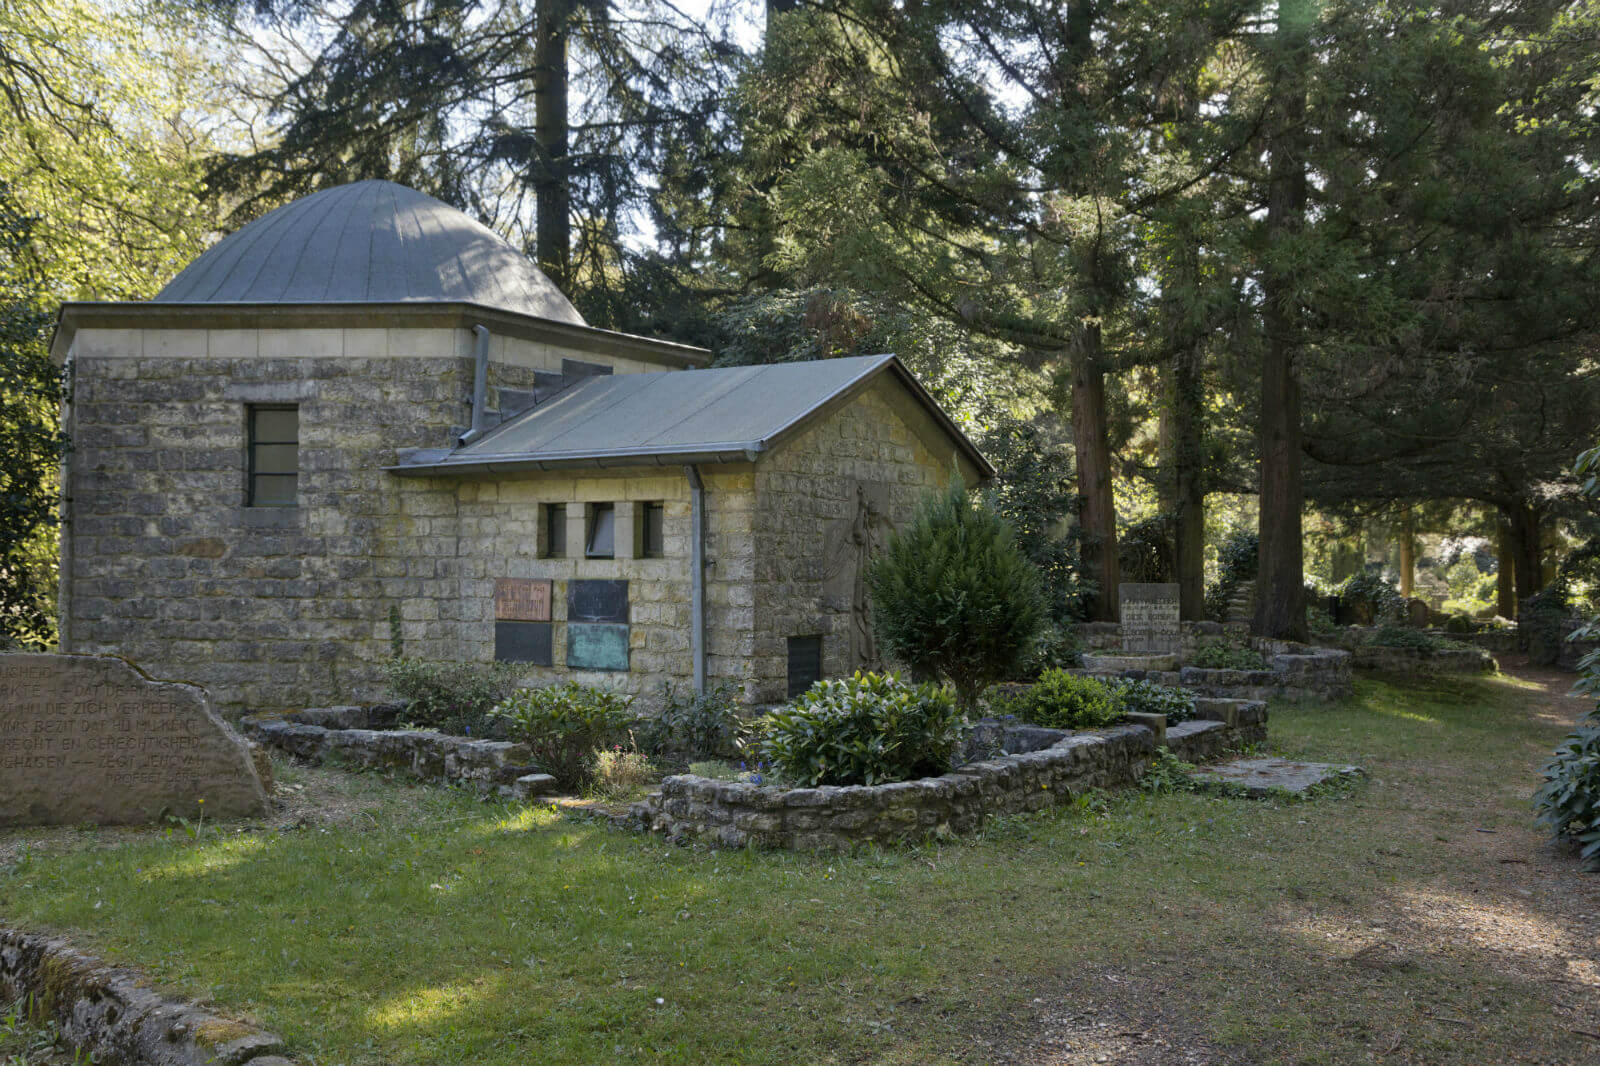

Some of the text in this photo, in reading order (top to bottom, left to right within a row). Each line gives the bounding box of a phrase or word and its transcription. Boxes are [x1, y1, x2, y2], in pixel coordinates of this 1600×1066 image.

[75, 684, 104, 698] DAT
[46, 702, 68, 715] DIE
[72, 702, 108, 715] ZICH
[33, 719, 77, 733] BEZIT
[62, 737, 81, 750] EN
